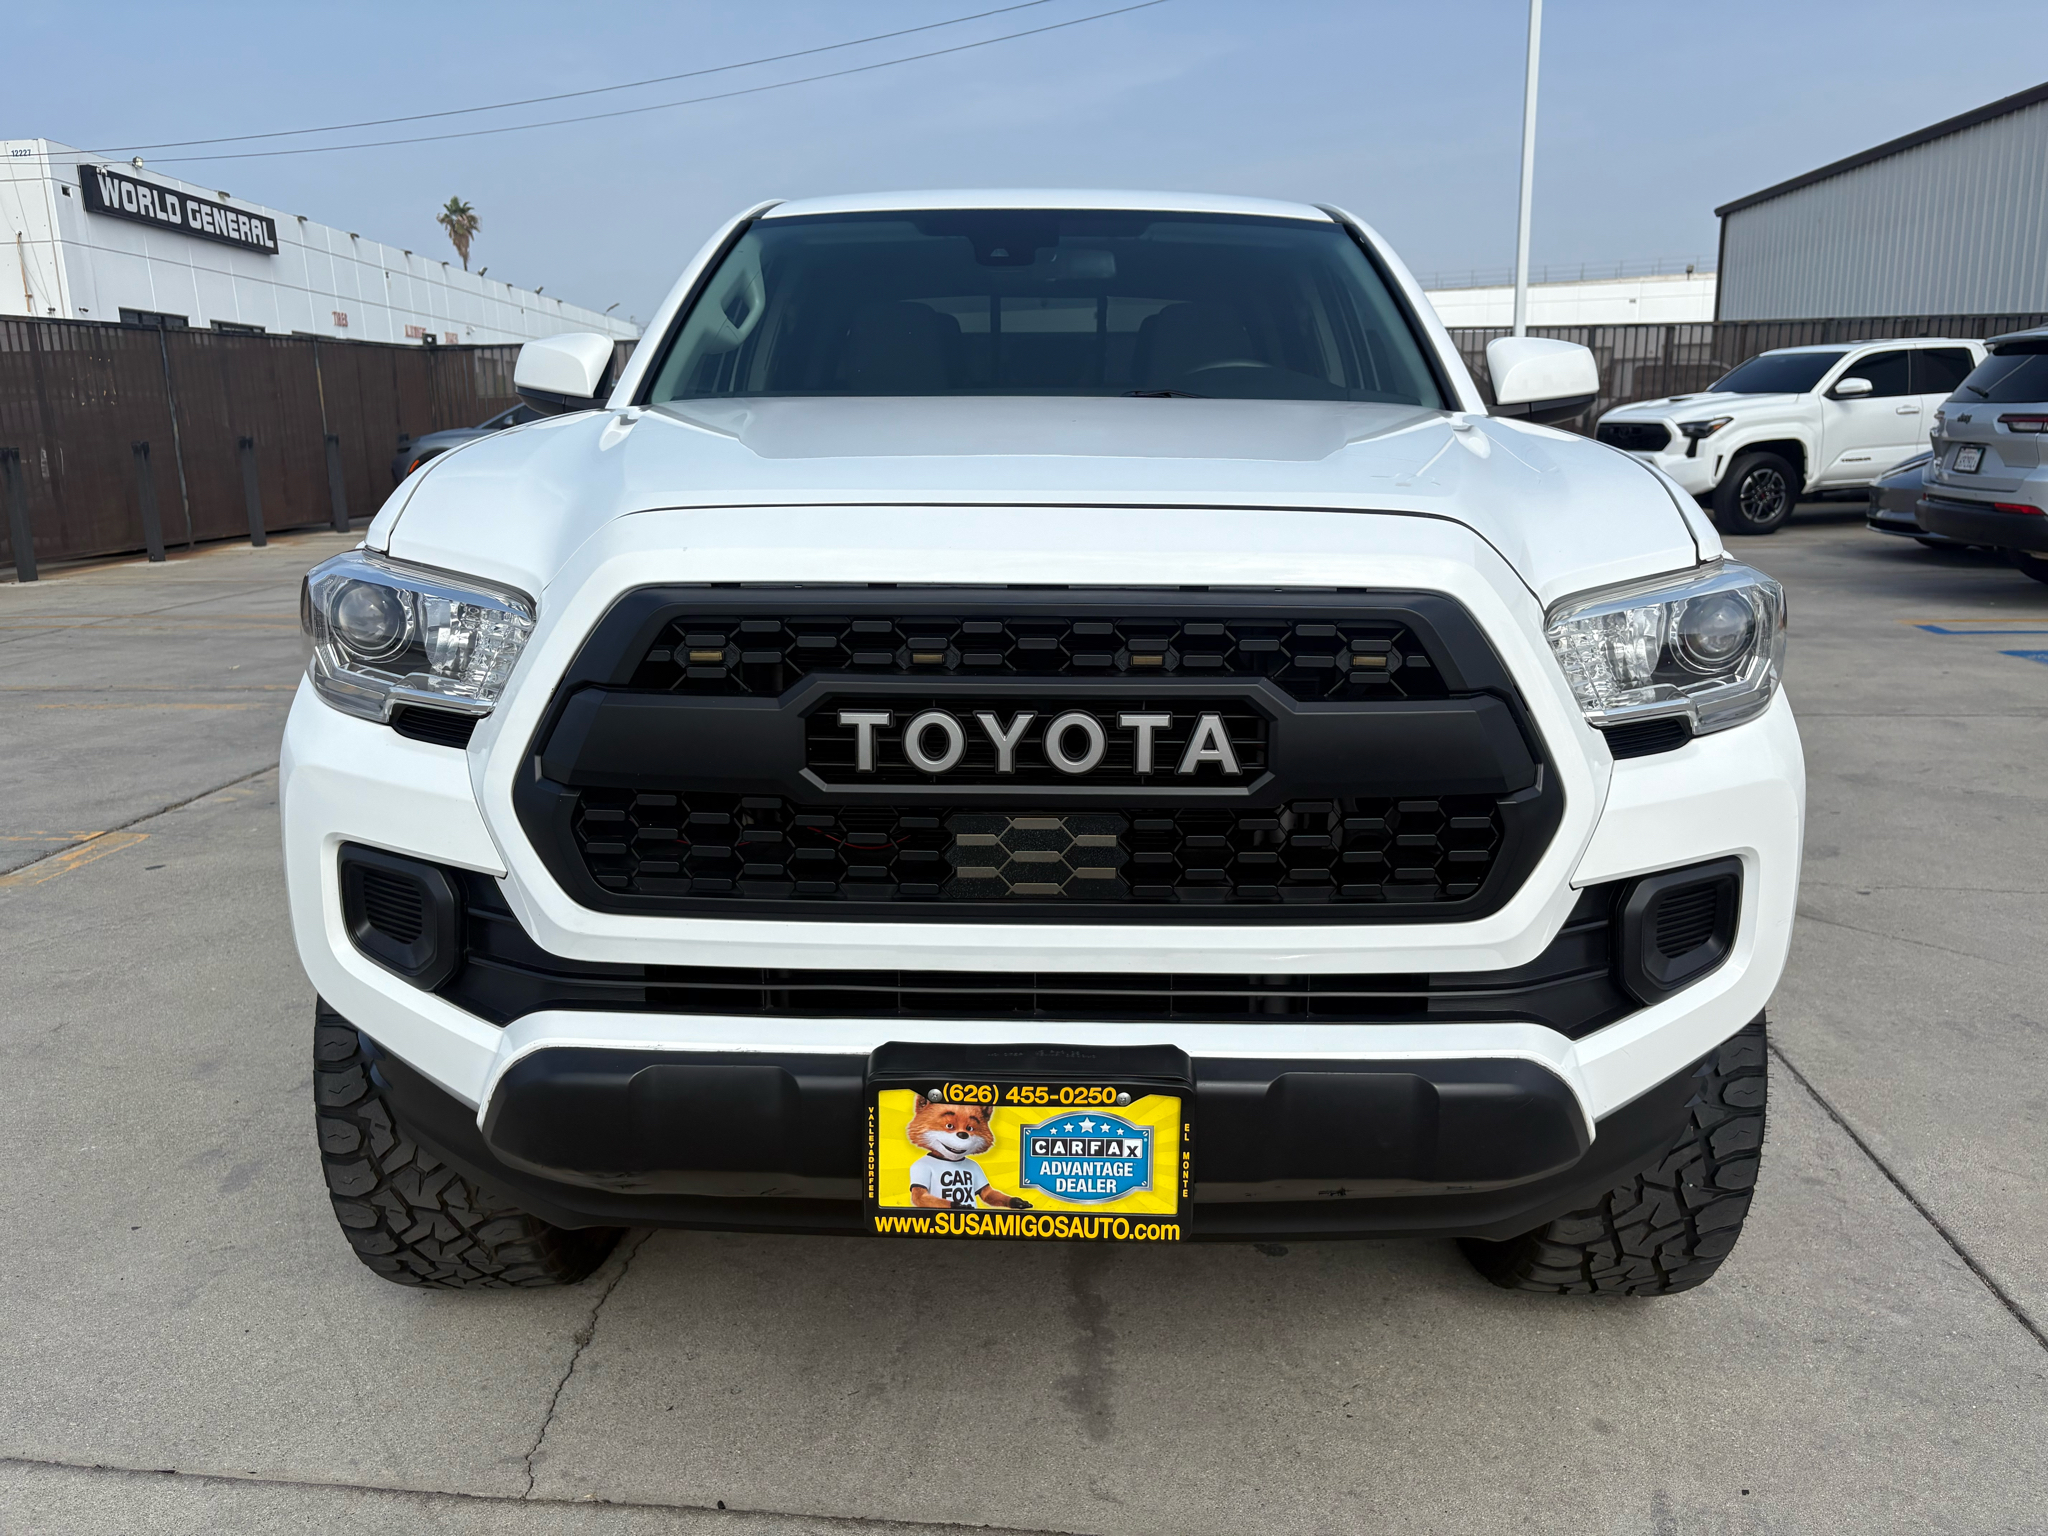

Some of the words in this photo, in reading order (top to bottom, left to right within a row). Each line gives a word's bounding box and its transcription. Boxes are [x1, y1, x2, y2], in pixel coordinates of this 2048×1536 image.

[11, 149, 31, 157] 12227
[97, 173, 182, 225] WORLD
[186, 199, 275, 249] GENERAL
[838, 710, 1242, 775] TOYOTA
[942, 1082, 999, 1104] (626)
[1005, 1086, 1117, 1105] 455-0250
[1034, 1140, 1139, 1157] CARFAX
[1039, 1160, 1134, 1177] ADVANTAGE
[940, 1170, 973, 1187] CAR
[1055, 1178, 1117, 1193] DEALER
[941, 1187, 975, 1203] FOX
[874, 1213, 1181, 1241] www.SUSAMIGOSAUTO.com
